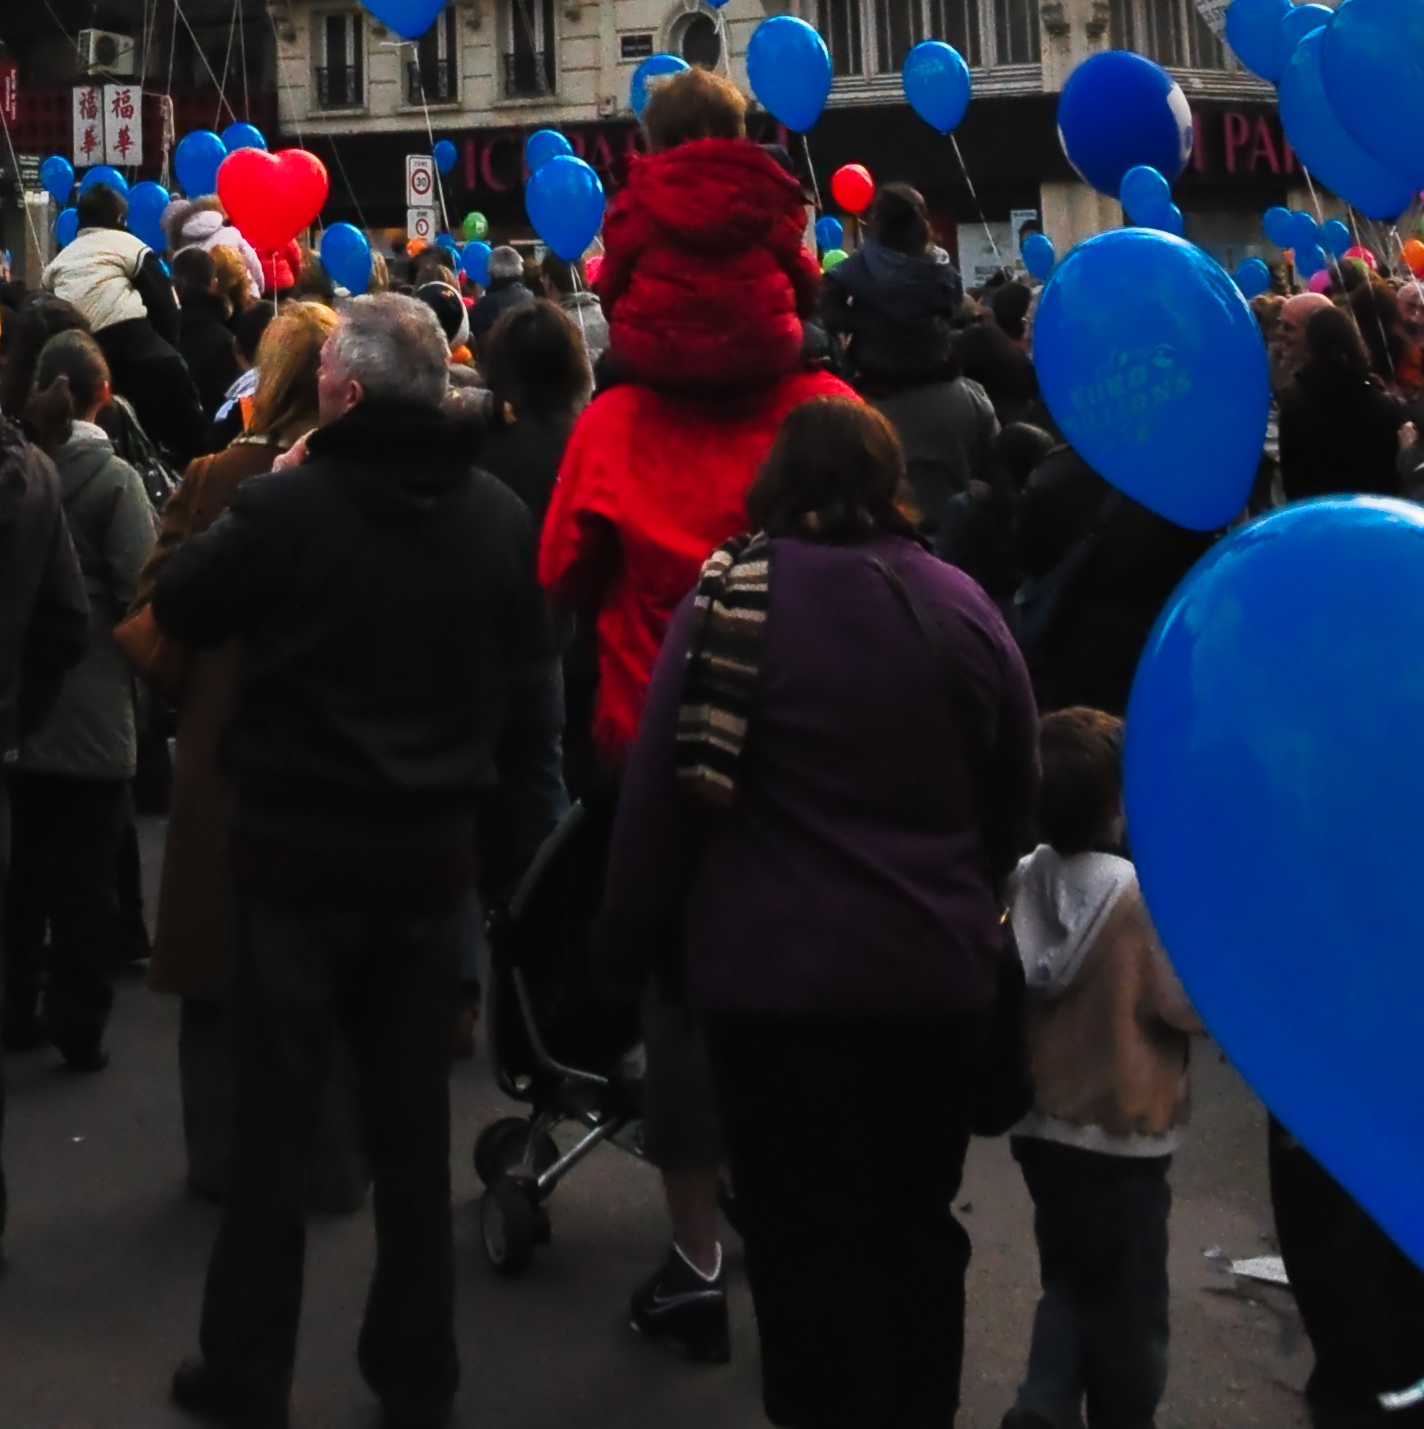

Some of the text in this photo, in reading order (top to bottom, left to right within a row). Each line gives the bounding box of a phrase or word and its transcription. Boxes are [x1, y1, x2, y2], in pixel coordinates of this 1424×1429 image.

[79, 89, 101, 161] 福華
[111, 87, 135, 162] 福華
[416, 176, 427, 188] 30
